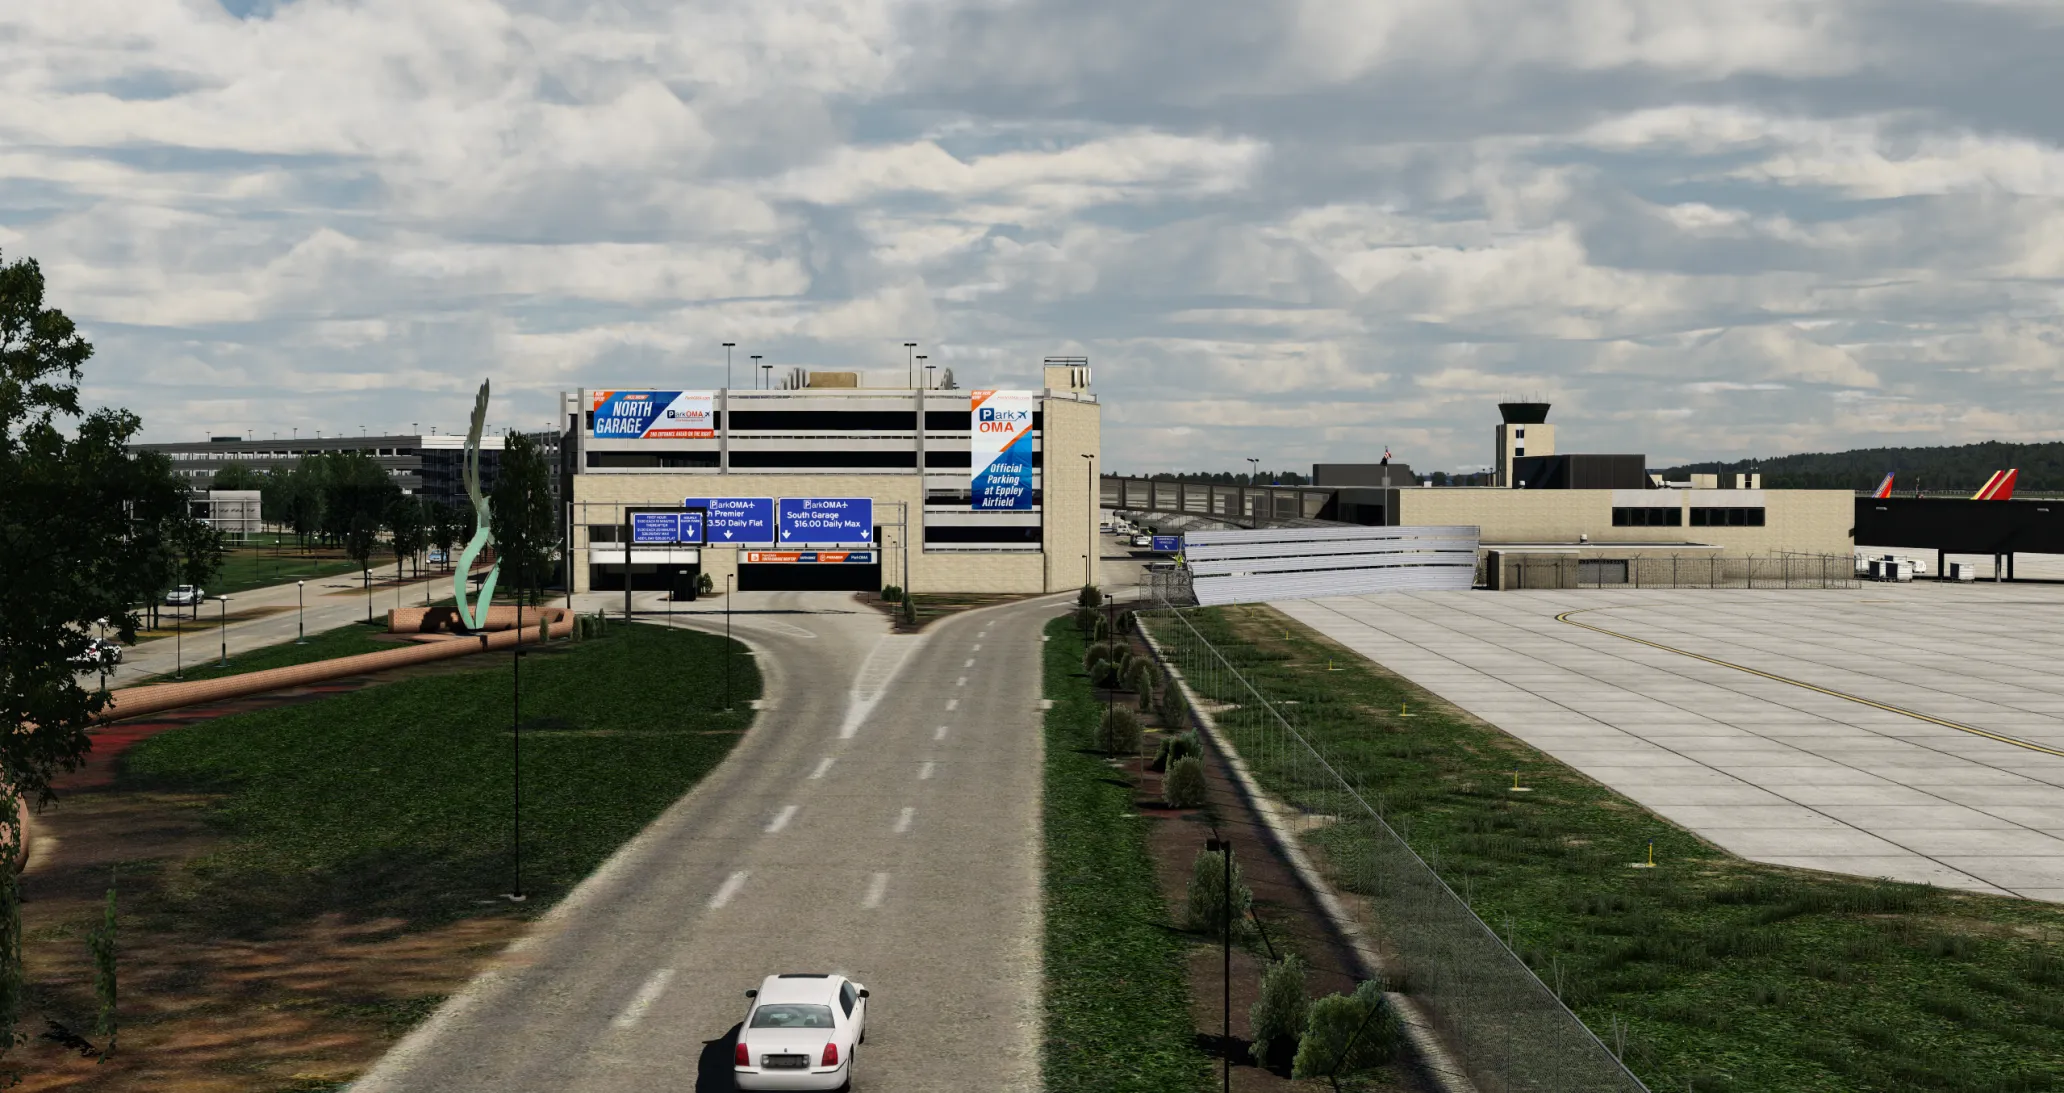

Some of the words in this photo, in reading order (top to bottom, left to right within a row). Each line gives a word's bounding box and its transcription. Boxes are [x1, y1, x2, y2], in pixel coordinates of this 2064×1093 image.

[612, 401, 653, 417] NORTH
[980, 408, 1015, 421] Park
[596, 417, 643, 434] GARAGE
[980, 422, 1015, 433] OMA
[990, 464, 1022, 473] Official
[987, 475, 1020, 486] Parking
[984, 486, 994, 495] at
[995, 486, 1024, 497] Eppley
[982, 498, 1015, 507] Airfield
[714, 510, 745, 518] Premier
[787, 511, 810, 519] South
[811, 511, 840, 521] Garage
[728, 519, 748, 528] Daily
[748, 519, 764, 527] Flat
[794, 520, 821, 528] $16.00
[823, 520, 843, 529] Daily
[844, 520, 861, 528] Max
